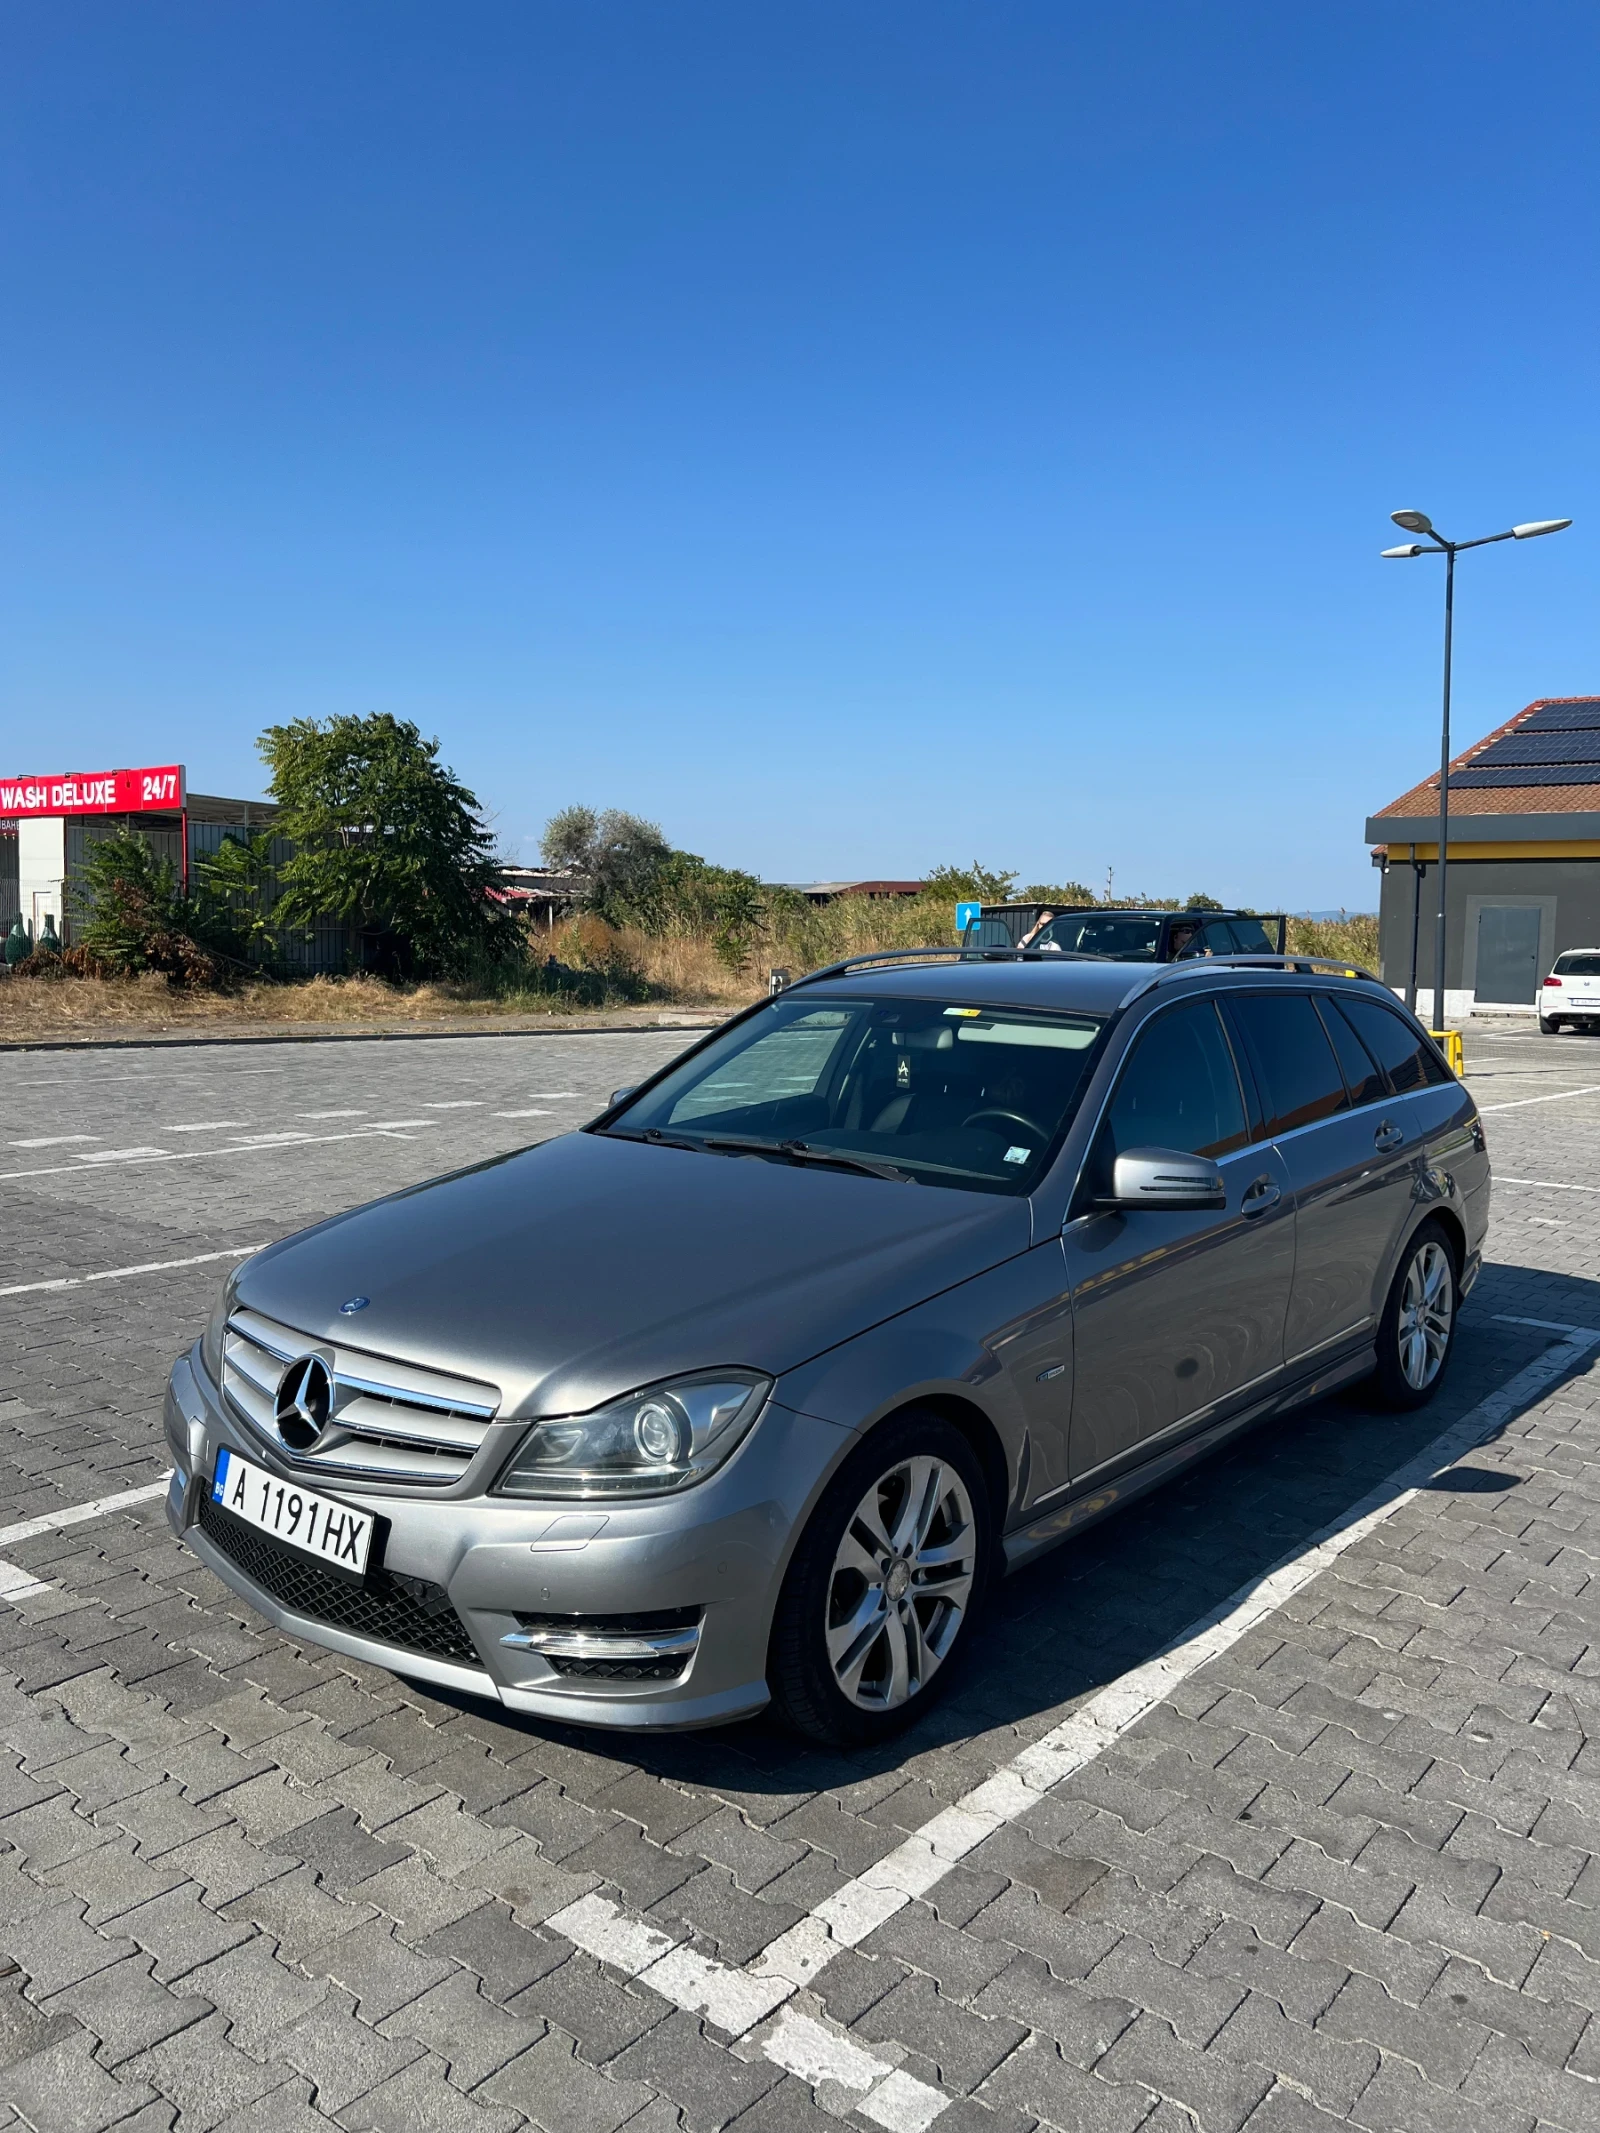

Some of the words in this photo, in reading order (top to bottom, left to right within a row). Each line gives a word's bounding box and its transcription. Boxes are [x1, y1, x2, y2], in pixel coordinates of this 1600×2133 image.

[1, 785, 47, 808] WASH
[52, 780, 116, 806] DELUXE
[143, 775, 176, 800] 24/7
[215, 1481, 224, 1496] BG
[232, 1468, 246, 1510] A
